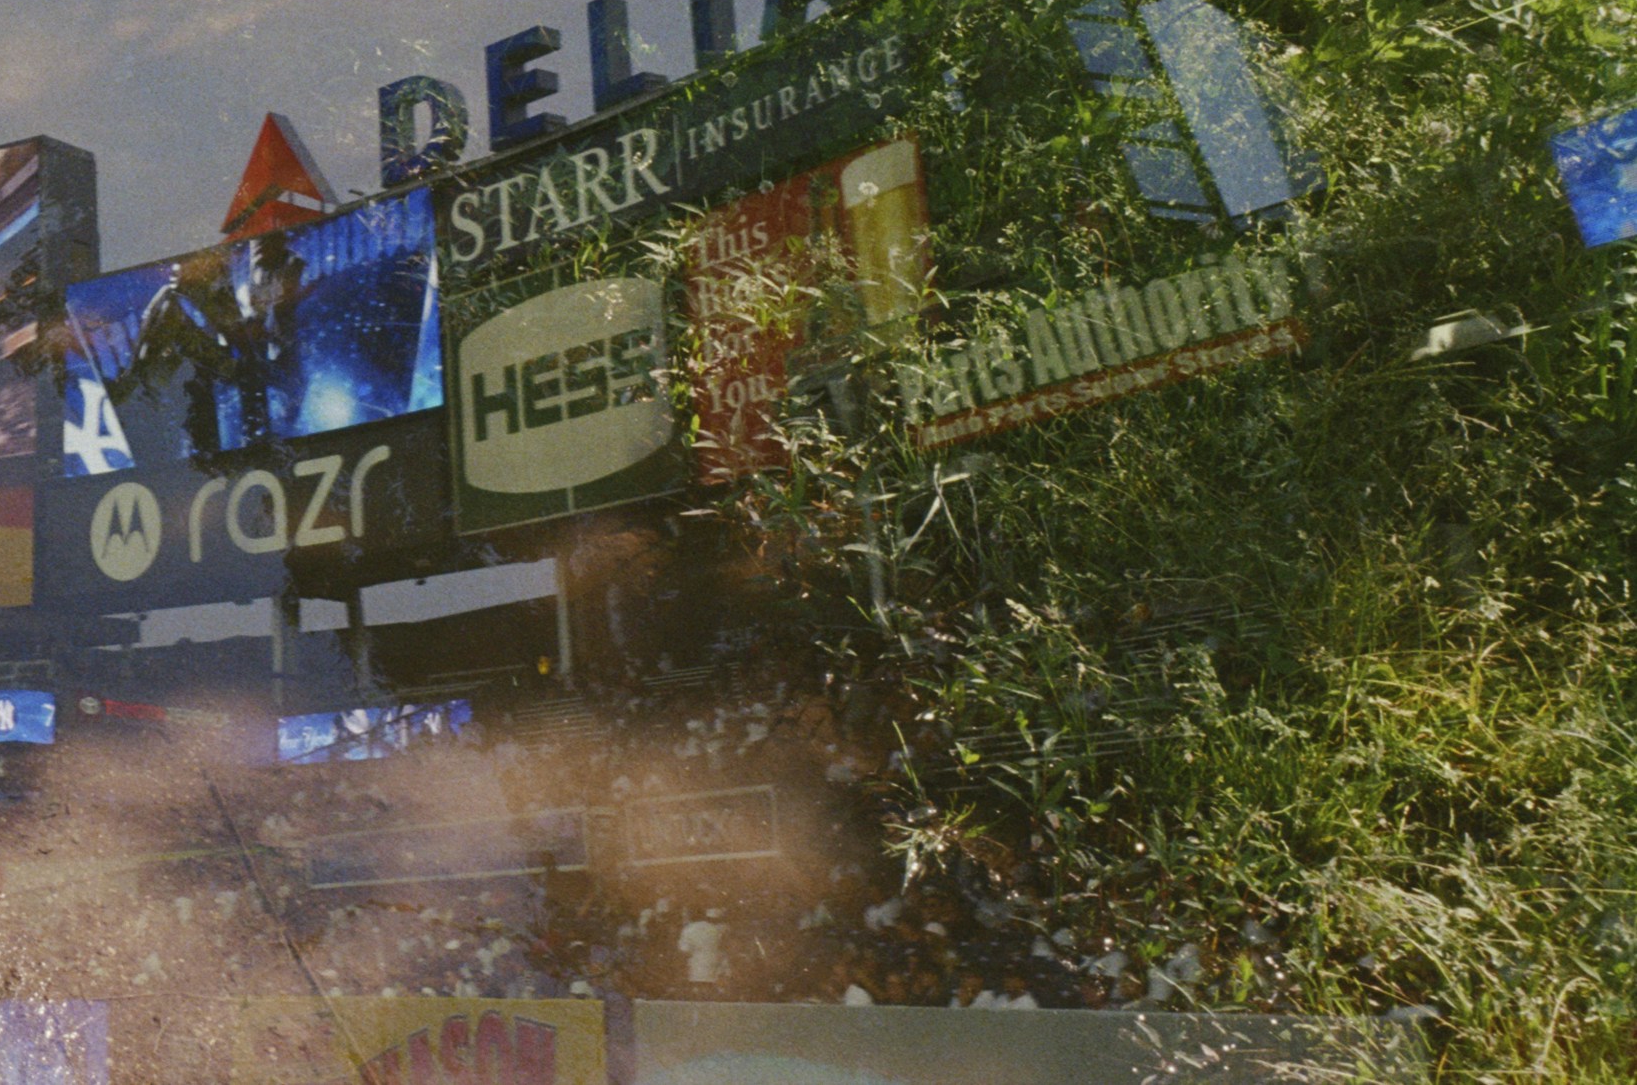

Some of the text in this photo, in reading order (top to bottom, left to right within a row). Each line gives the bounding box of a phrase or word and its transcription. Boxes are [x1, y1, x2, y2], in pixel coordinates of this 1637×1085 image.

[450, 34, 903, 263] STARR INSURANCE
[471, 325, 659, 443] HESS
[188, 444, 392, 563] razr
